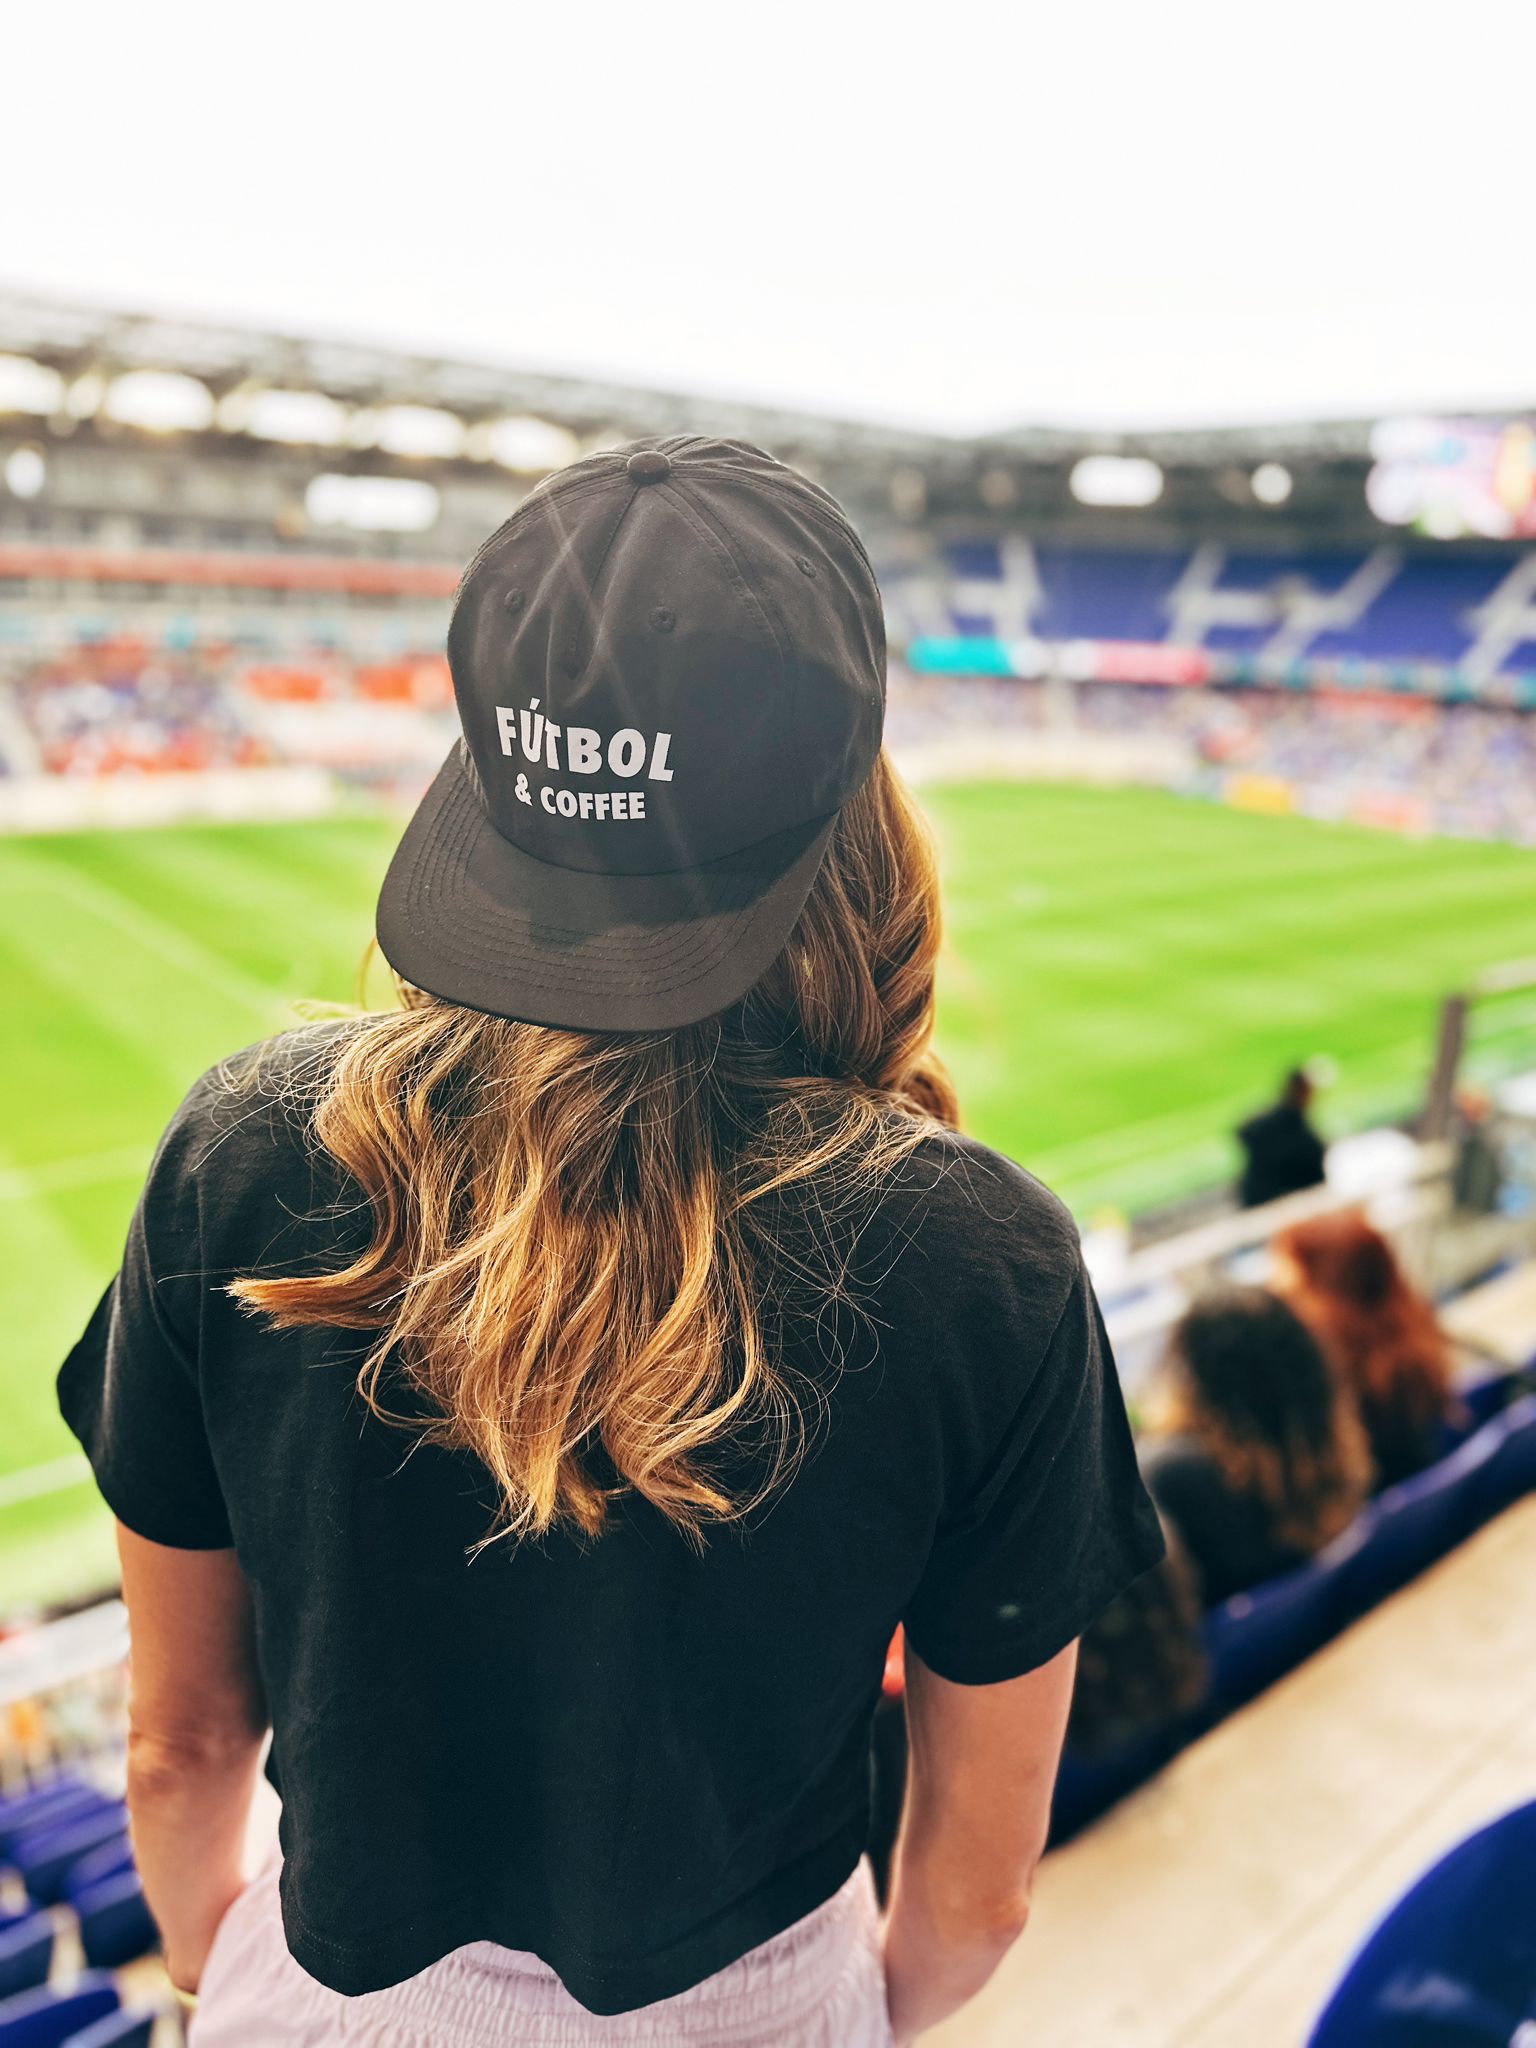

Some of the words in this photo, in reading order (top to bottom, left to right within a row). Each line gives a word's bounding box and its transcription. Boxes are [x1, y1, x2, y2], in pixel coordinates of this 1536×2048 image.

[495, 697, 675, 782] FÚTBOL
[514, 773, 533, 806] &
[540, 786, 646, 820] COFFEE
